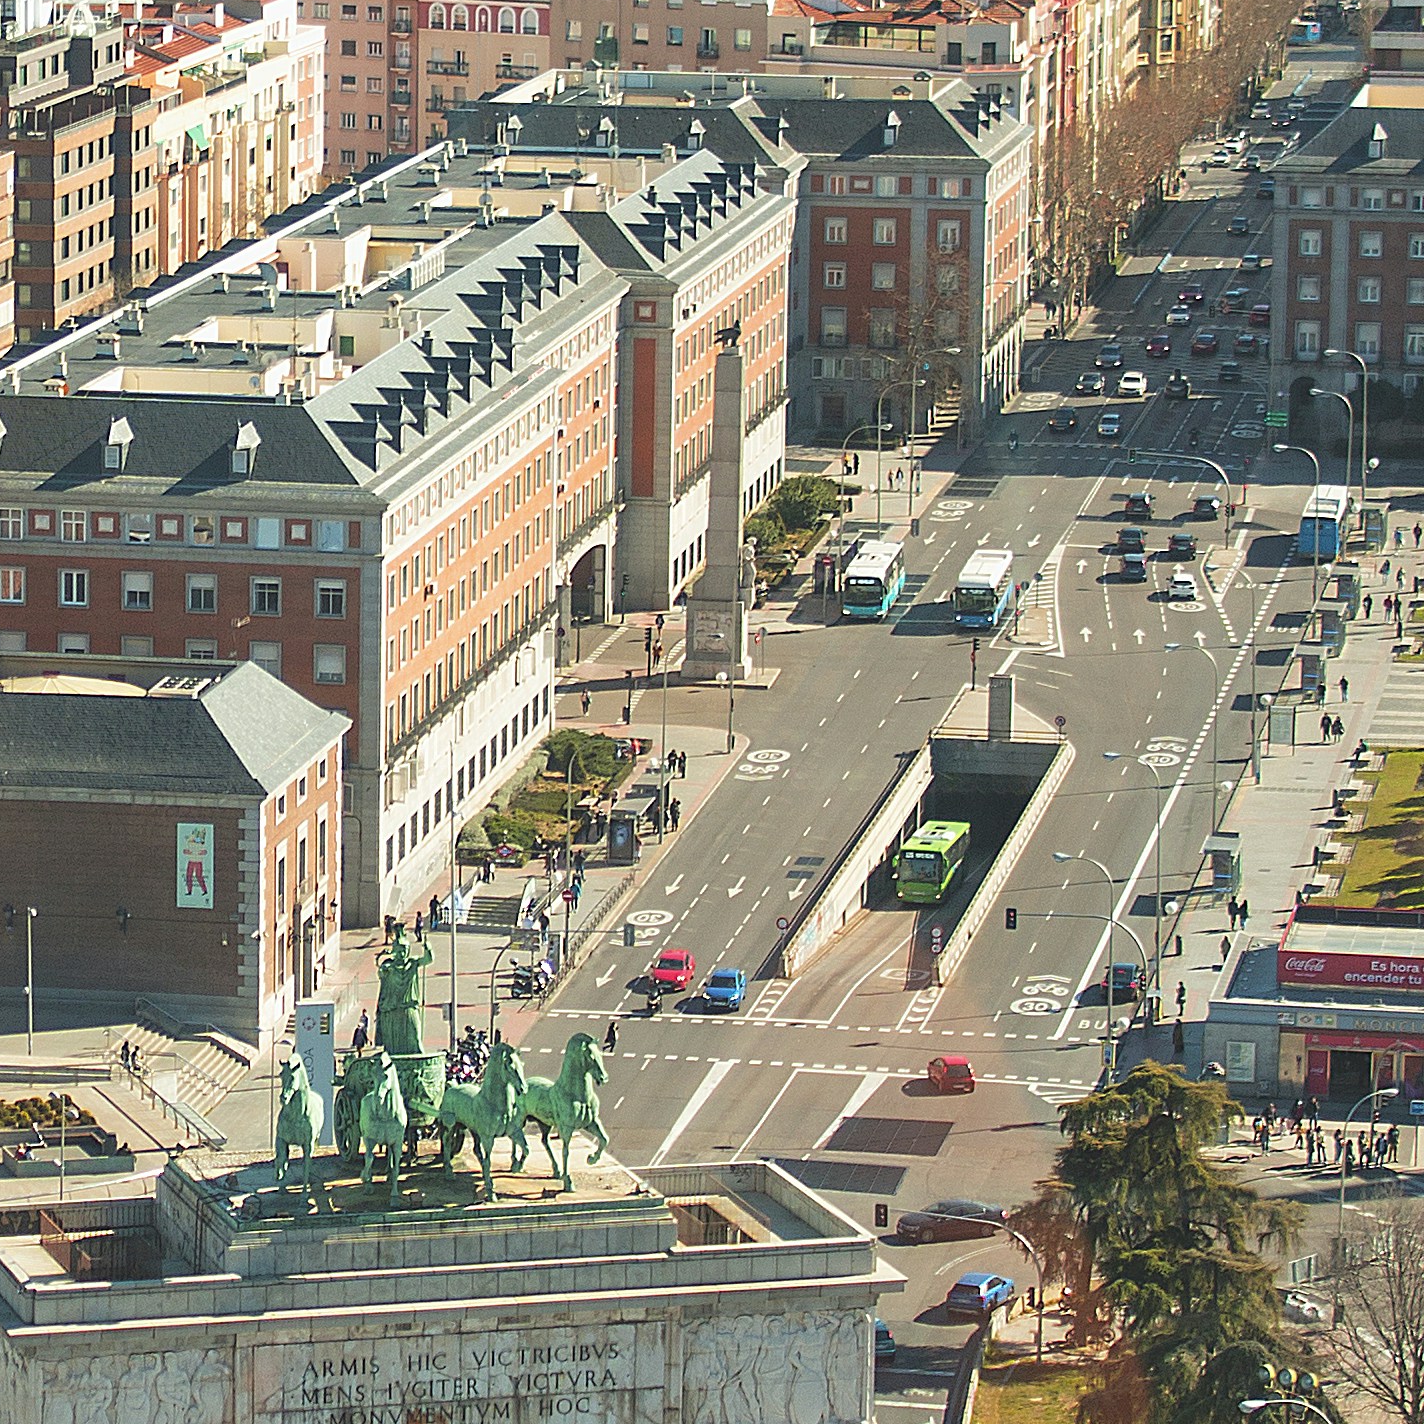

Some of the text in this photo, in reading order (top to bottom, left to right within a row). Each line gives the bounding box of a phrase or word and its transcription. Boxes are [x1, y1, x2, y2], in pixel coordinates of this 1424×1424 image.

[1371, 961, 1419, 973] Es hora
[1344, 972, 1422, 985] encender tu
[1022, 1001, 1049, 1012] 30
[1355, 1018, 1424, 1034] MONCL
[302, 1343, 620, 1378] ARMIS HIC VICTRICIBVS
[301, 1368, 616, 1406] MENS IVGITER VICTVRA
[538, 1396, 590, 1417] HOC
